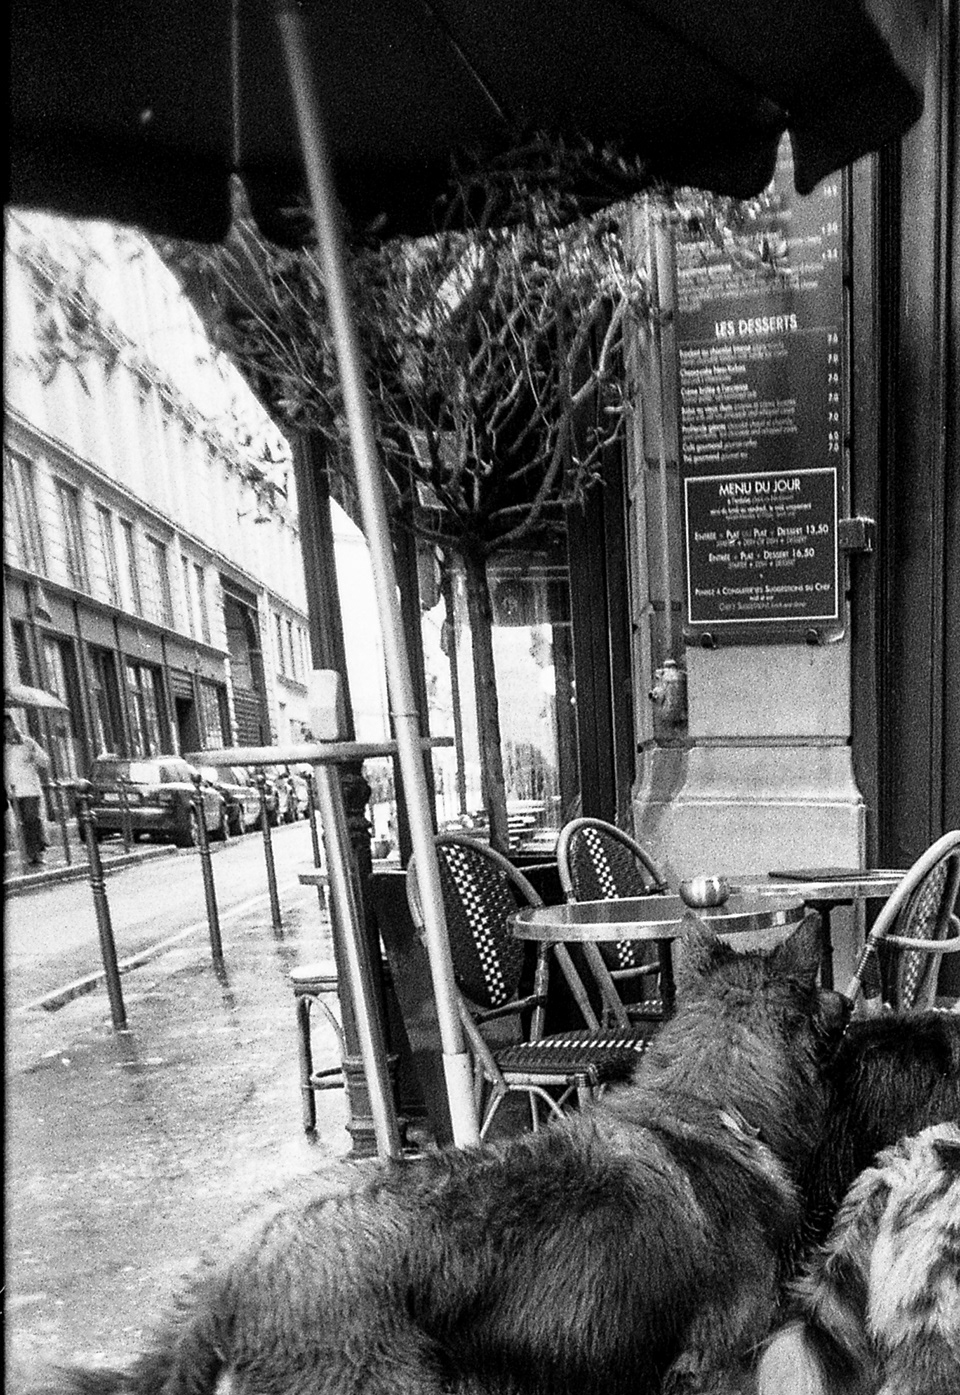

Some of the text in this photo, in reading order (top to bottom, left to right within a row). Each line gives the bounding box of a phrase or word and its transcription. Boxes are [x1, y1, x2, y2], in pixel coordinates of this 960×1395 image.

[716, 314, 798, 338] LES DESSERTS
[719, 478, 801, 496] MENU DU JOUR
